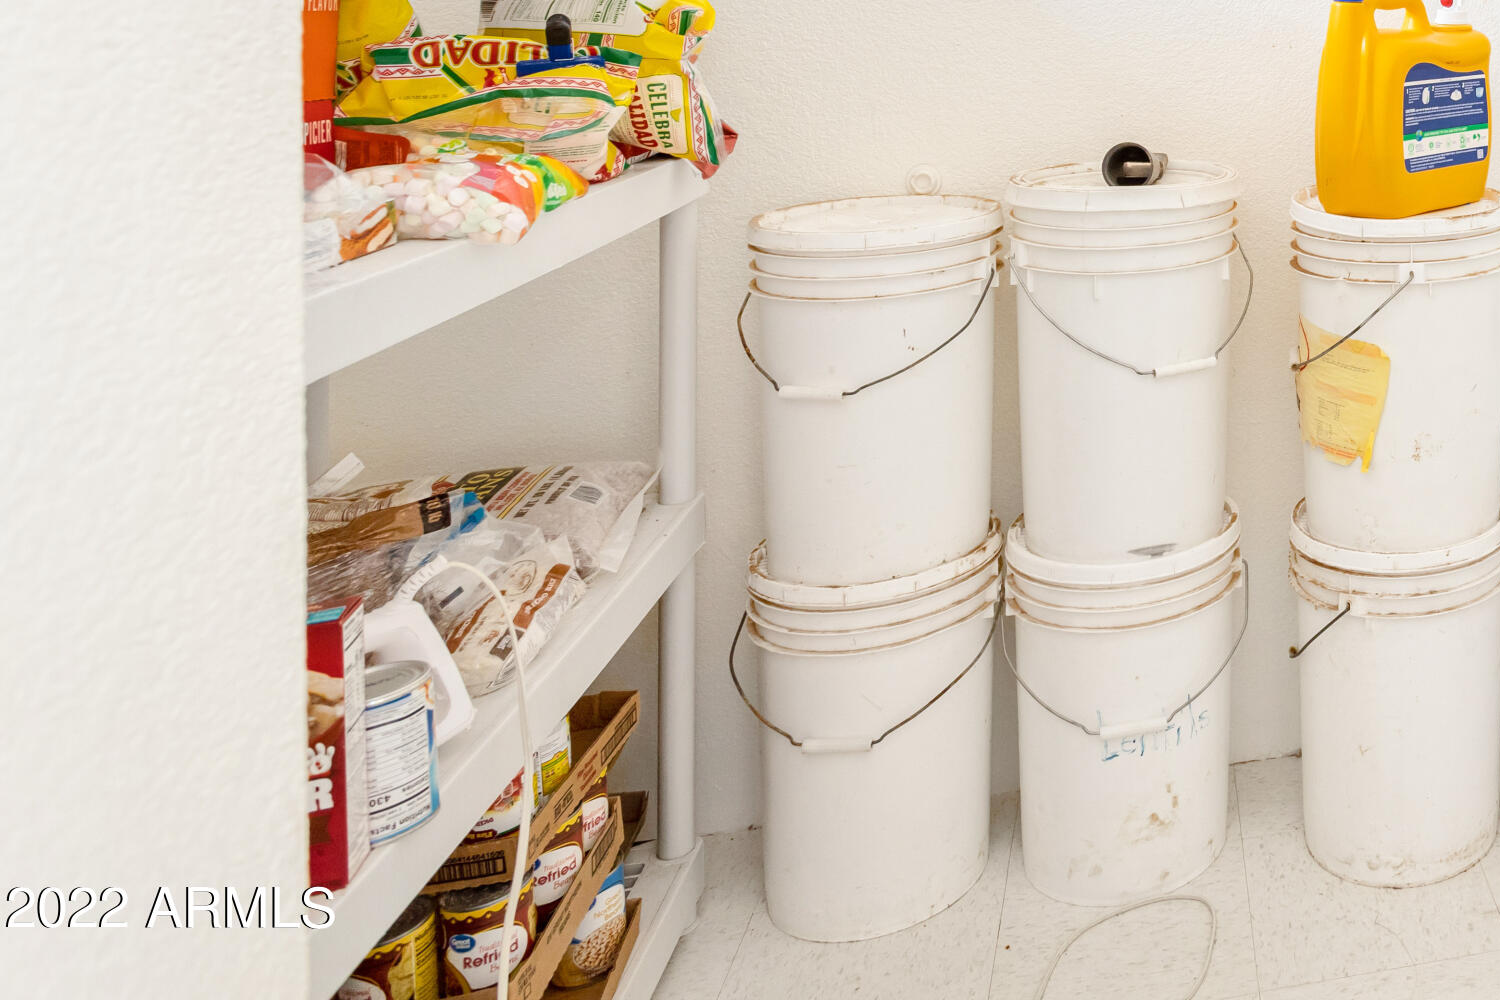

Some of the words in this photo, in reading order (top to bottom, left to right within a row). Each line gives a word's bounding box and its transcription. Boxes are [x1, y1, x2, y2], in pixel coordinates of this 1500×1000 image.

[412, 39, 599, 68] LIDAD
[646, 82, 674, 150] CELEBRA
[303, 119, 332, 146] PICIER
[369, 795, 391, 808] 430
[462, 938, 519, 970] Refrid
